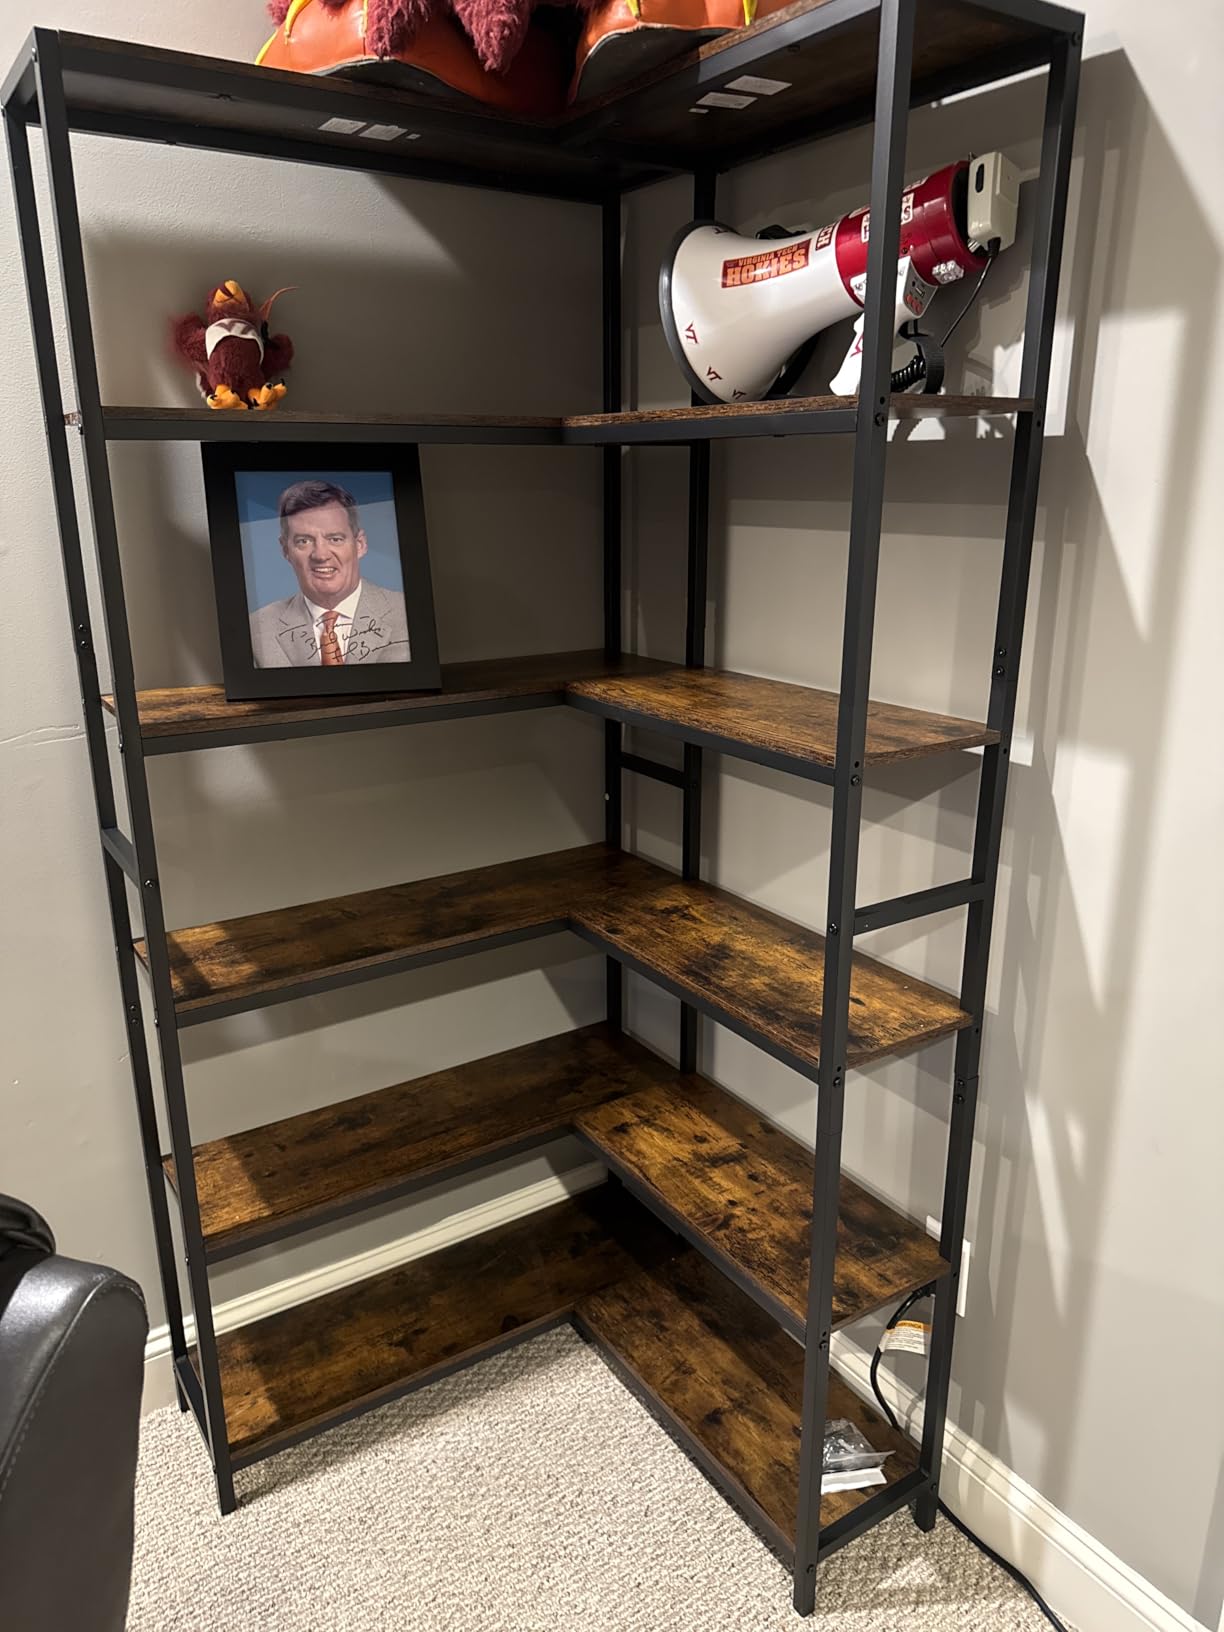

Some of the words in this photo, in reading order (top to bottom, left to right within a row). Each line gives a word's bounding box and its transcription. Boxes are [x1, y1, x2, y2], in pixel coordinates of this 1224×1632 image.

[726, 248, 806, 286] HOKIES
[739, 251, 775, 266] VIRGINIA
[777, 245, 799, 258] TECH
